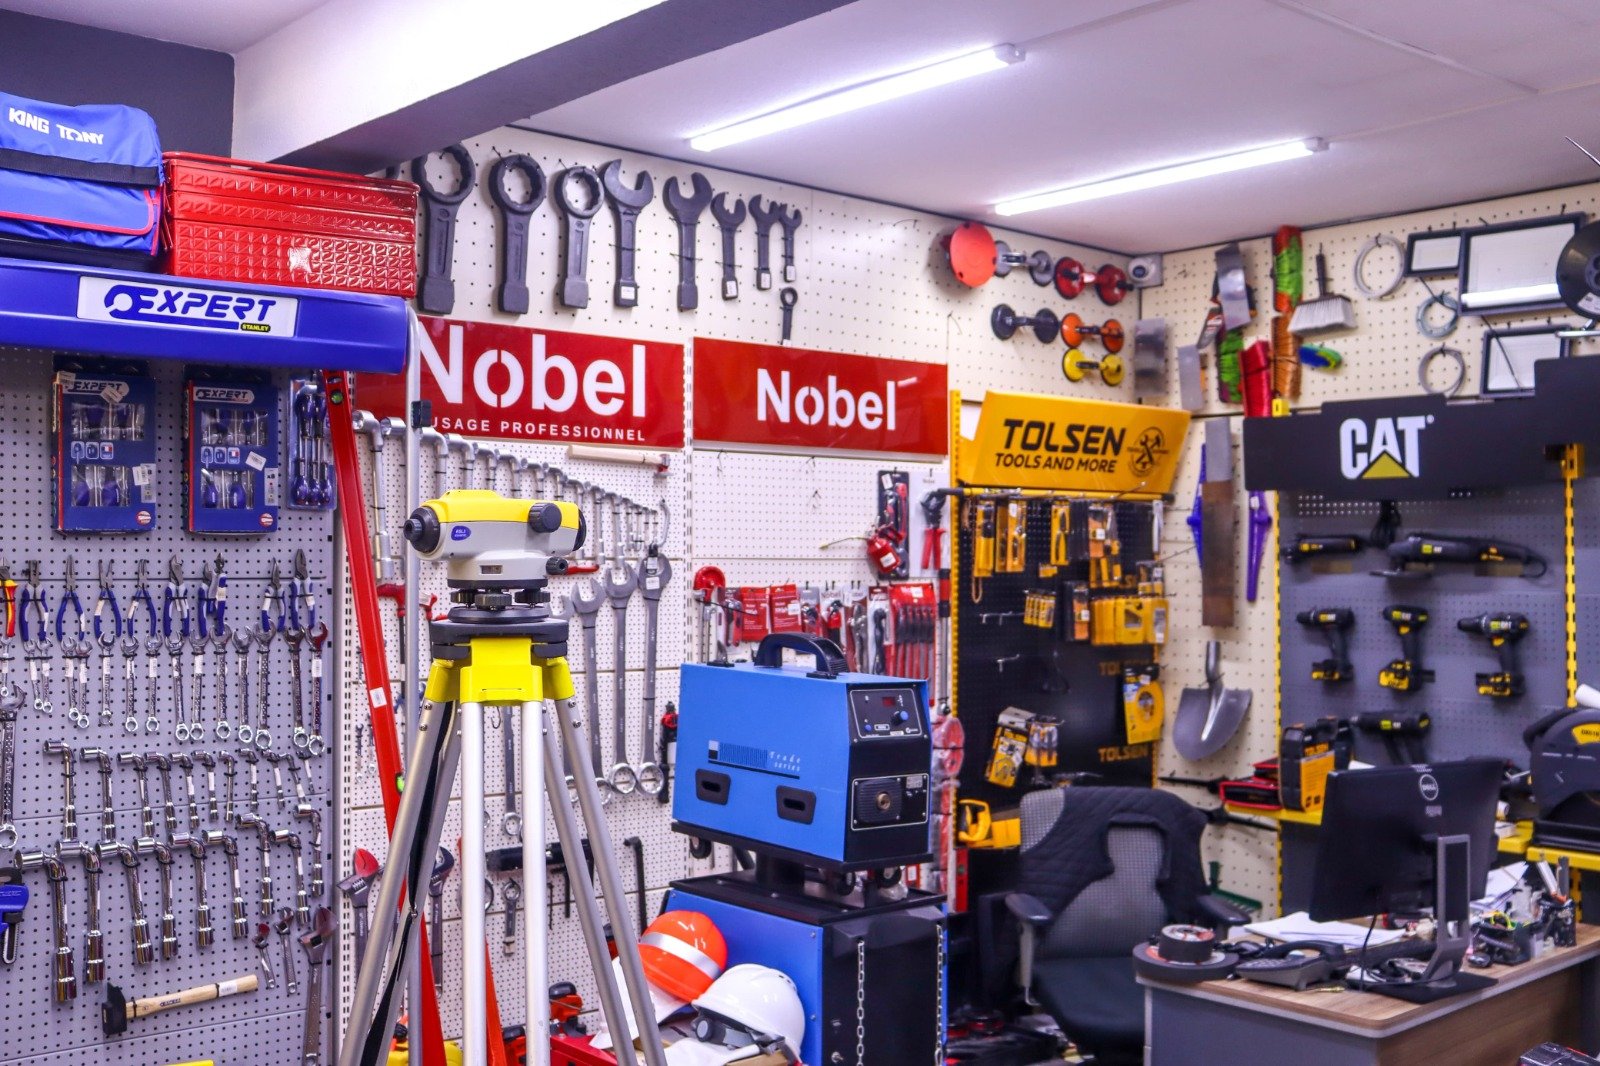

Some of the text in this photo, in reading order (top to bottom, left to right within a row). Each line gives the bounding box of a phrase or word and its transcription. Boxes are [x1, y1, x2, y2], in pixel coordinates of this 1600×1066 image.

[9, 107, 104, 145] KING TONY
[242, 323, 270, 332] STANLEY
[420, 323, 646, 419] Nobel
[757, 368, 897, 431] Nobel
[500, 421, 646, 442] PROFESSIONNEL
[1003, 418, 1126, 456] TOLSEN
[1340, 415, 1426, 480] CAT
[995, 452, 1118, 474] TOOLS AND MORE
